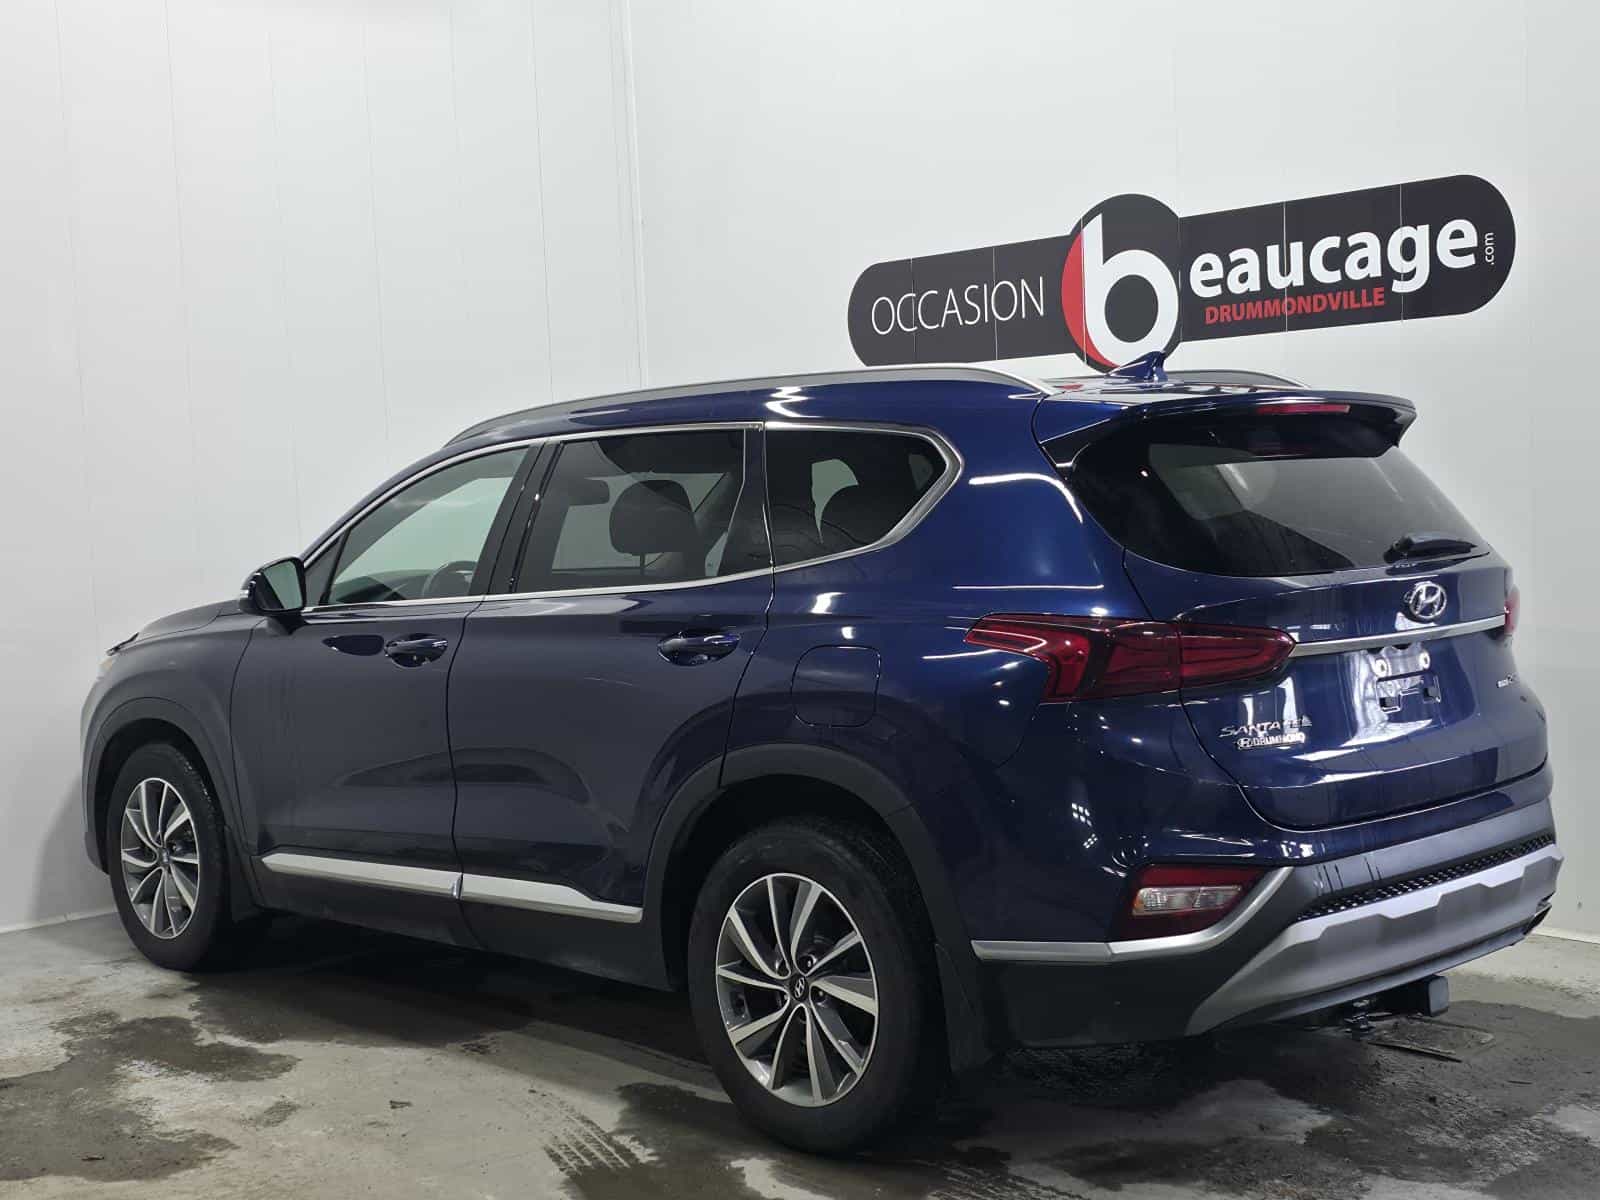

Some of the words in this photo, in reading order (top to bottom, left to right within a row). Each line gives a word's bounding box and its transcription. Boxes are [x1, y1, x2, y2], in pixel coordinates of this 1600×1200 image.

[1484, 232, 1495, 265] .com
[871, 276, 1044, 335] OCCASION
[1205, 287, 1385, 324] DRUMMONDVILLE
[1219, 721, 1281, 738] SANTA
